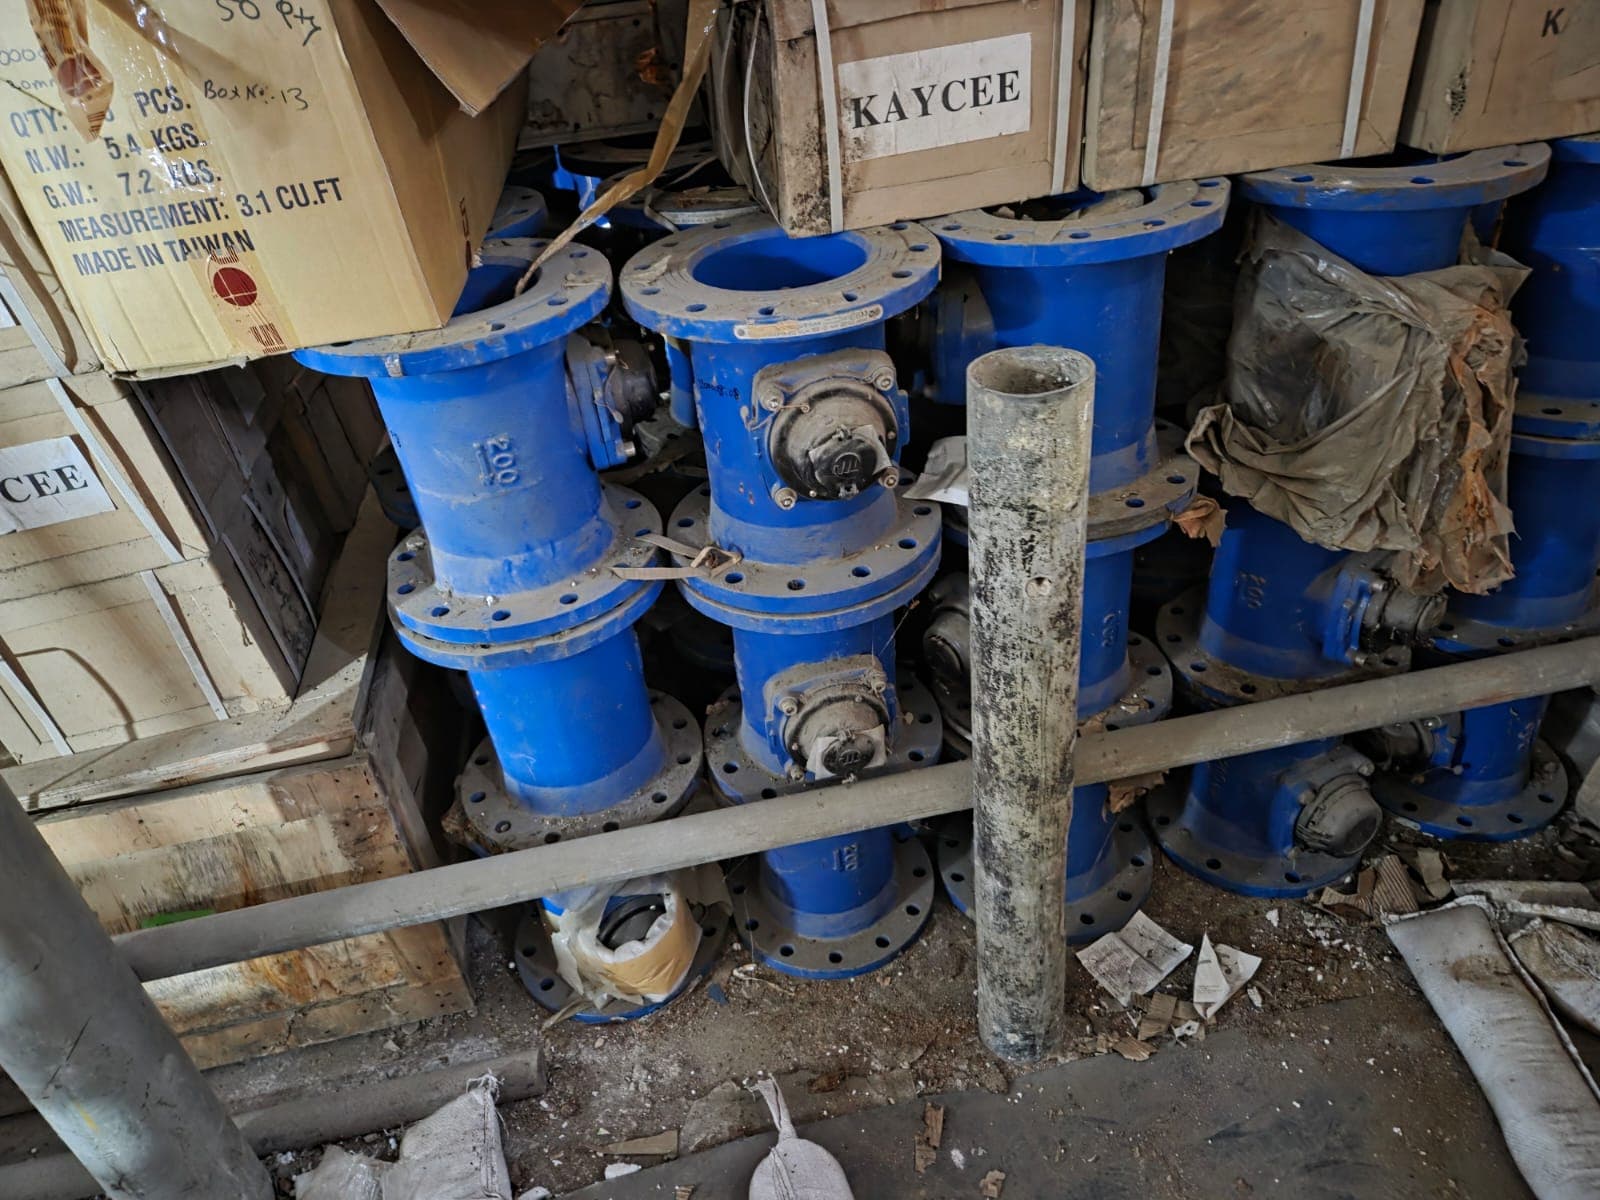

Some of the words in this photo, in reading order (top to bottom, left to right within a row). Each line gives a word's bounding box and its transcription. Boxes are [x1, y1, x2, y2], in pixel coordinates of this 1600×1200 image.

[1541, 7, 1565, 37] K
[134, 85, 191, 117] PCS.
[204, 79, 241, 100] Box
[850, 70, 1021, 130] KAYCEE
[25, 145, 85, 174] N.W.:
[104, 133, 142, 160] 5.4
[42, 181, 98, 209] G.W.:
[117, 169, 155, 196] 7.2
[58, 197, 230, 243] MEASUREMENT:
[236, 193, 272, 217] 3.1
[275, 177, 343, 210] CU.FT
[72, 247, 137, 276] MADE
[135, 243, 165, 267] IN
[163, 229, 255, 263] TAIWAN
[0, 464, 89, 503] CEE
